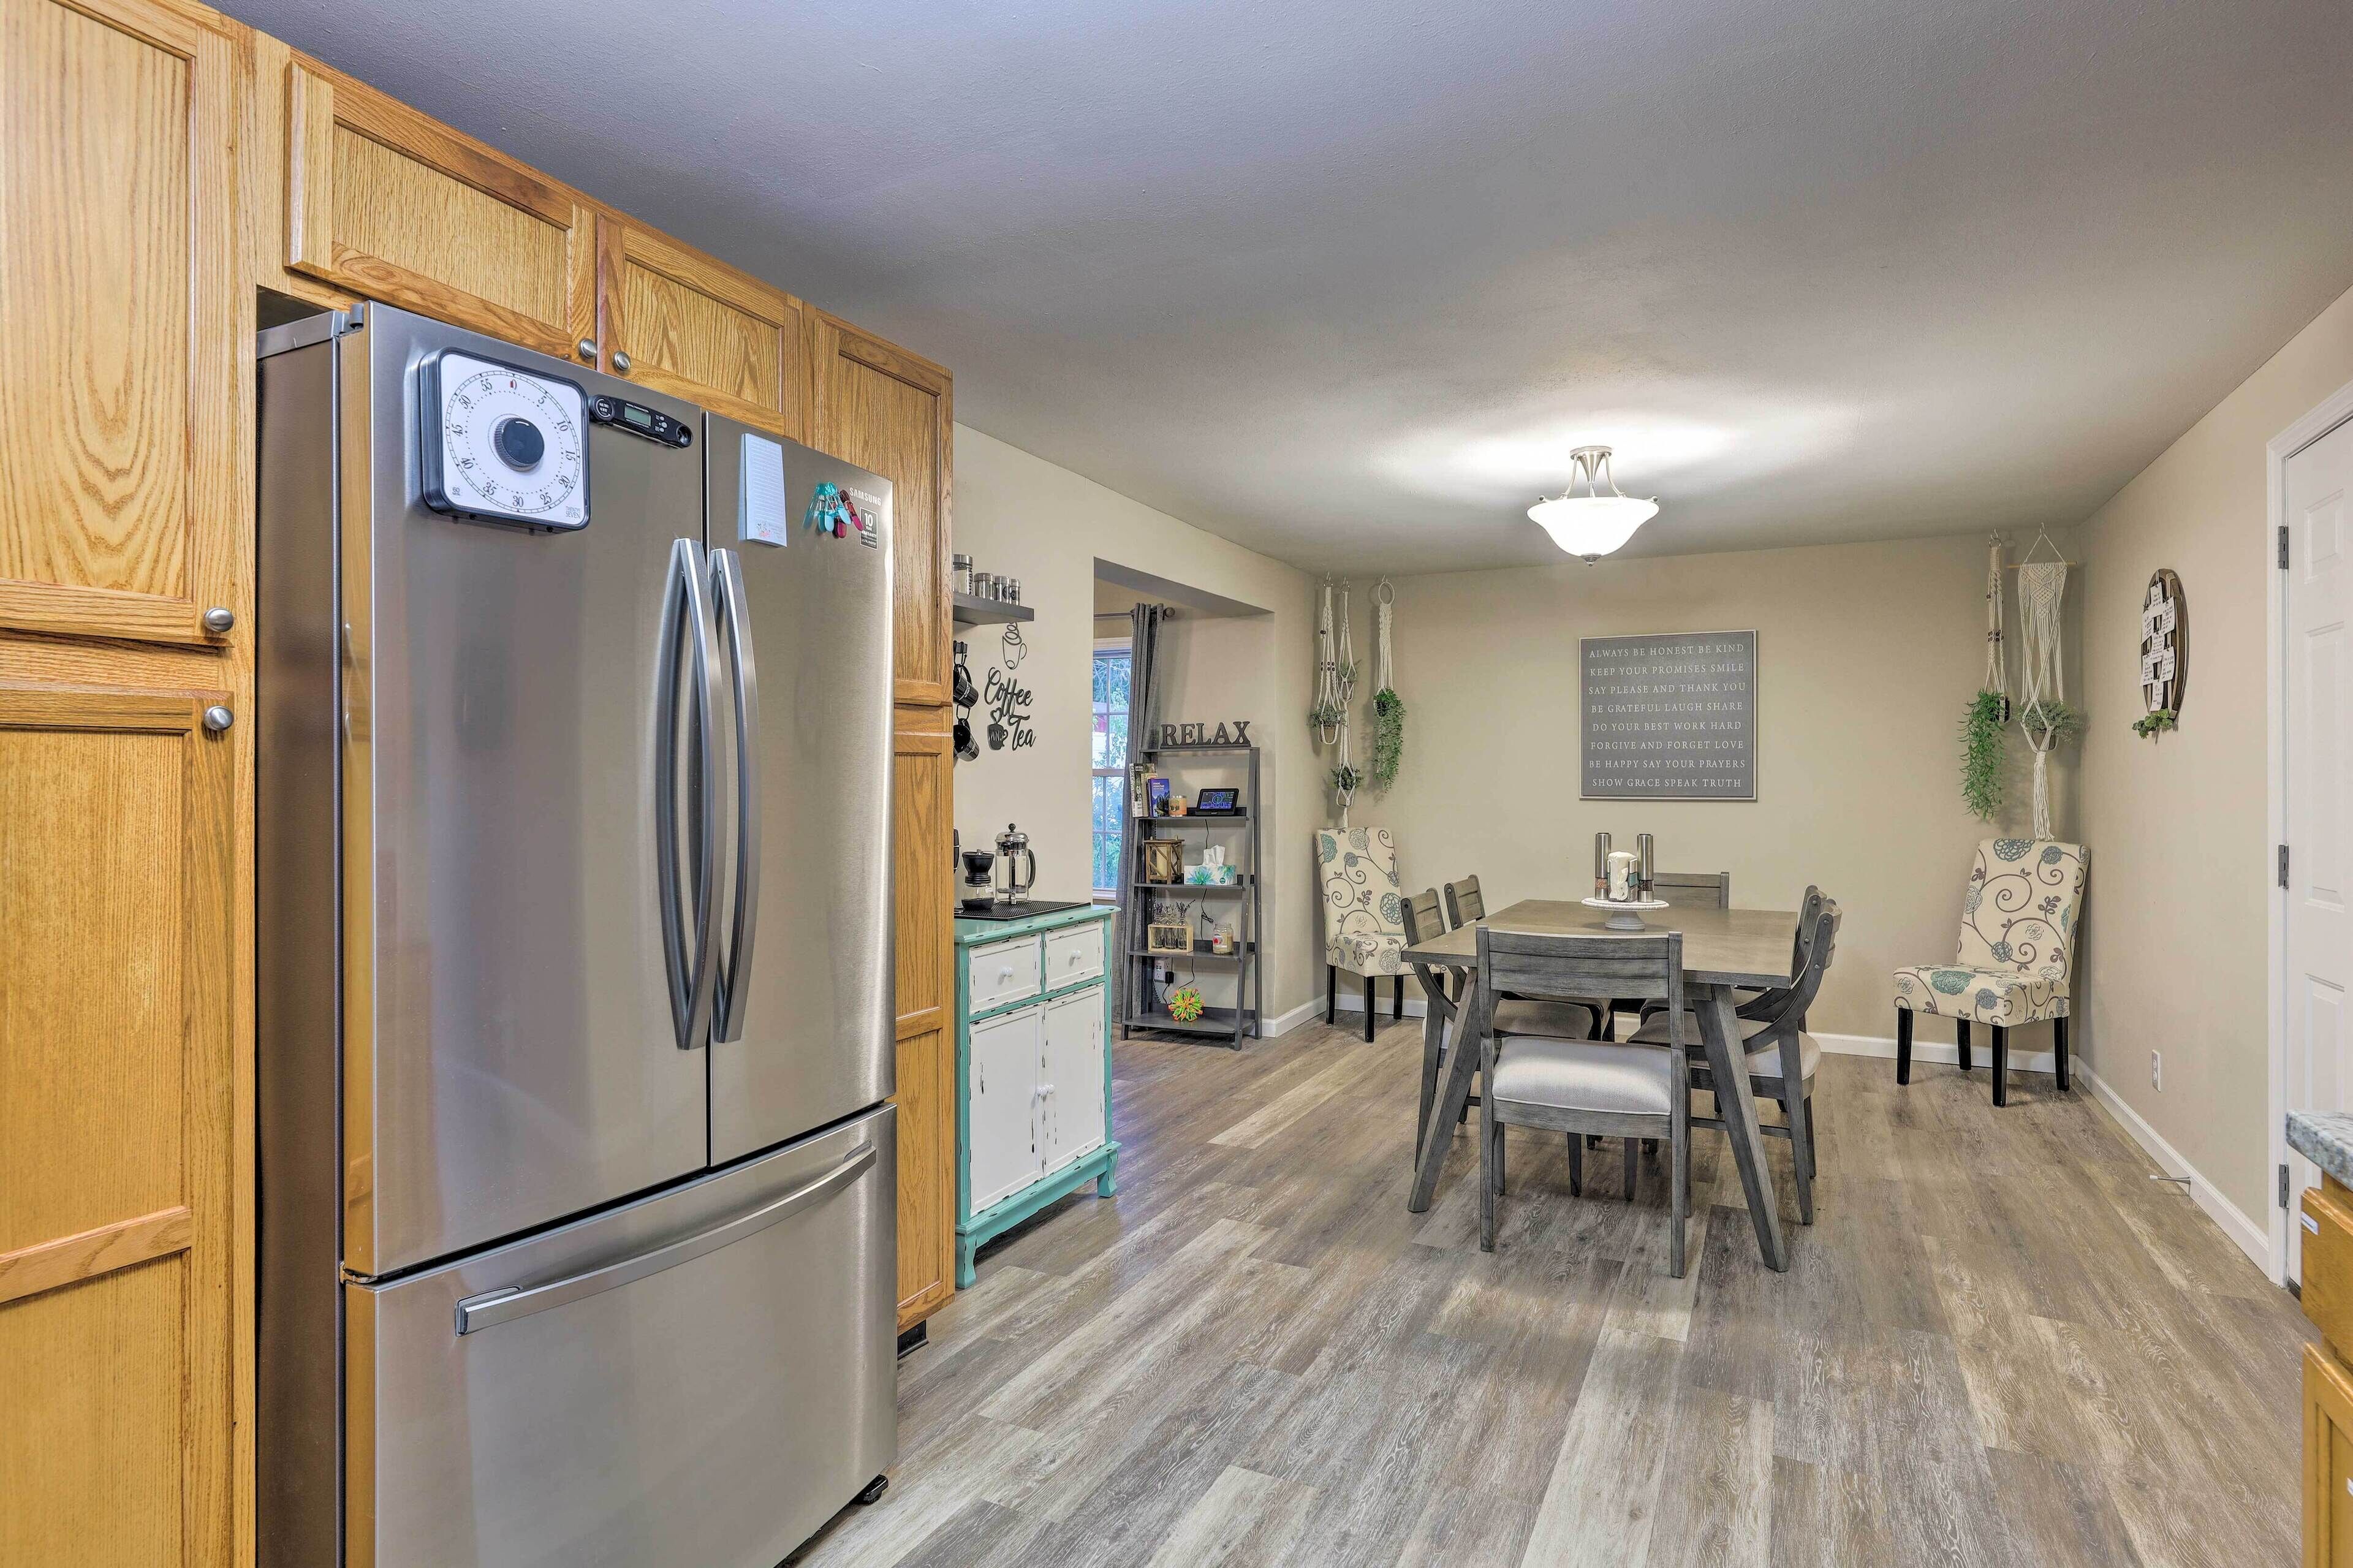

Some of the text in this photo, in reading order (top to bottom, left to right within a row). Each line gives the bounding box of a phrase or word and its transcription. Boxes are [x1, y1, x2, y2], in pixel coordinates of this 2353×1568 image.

[480, 378, 493, 392] 55
[458, 395, 471, 409] 50
[537, 395, 547, 404] 5
[452, 423, 463, 437] 45
[556, 420, 569, 432] 10
[566, 450, 576, 461] 15
[460, 457, 474, 469] 40
[558, 475, 570, 488] 20
[482, 482, 497, 496] 35
[512, 495, 524, 508] 30
[539, 492, 552, 506] 25
[849, 487, 882, 506] SAMSUNG
[864, 513, 873, 527] 10
[1589, 643, 1745, 658] ALWAYS BE HONEST BE KIND
[1590, 663, 1745, 676] KEEP YOUR PROMISES SMILE
[984, 667, 1033, 717] Coffee
[1588, 682, 1746, 695] SAY PLEASE AND THANK YOU
[1591, 702, 1743, 713] BE GRATEFUL LAUGH SHARE
[1008, 714, 1036, 751] Tea
[1593, 721, 1741, 732] DO YOUR BEST WORK HARD
[1161, 721, 1251, 746] RELAX
[1667, 741, 1710, 749] FORGET
[1715, 740, 1744, 749] LOVE
[1699, 759, 1745, 768] PRAYERS
[1592, 778, 1741, 787] SHOW GRACE SPEAK TRUTH
